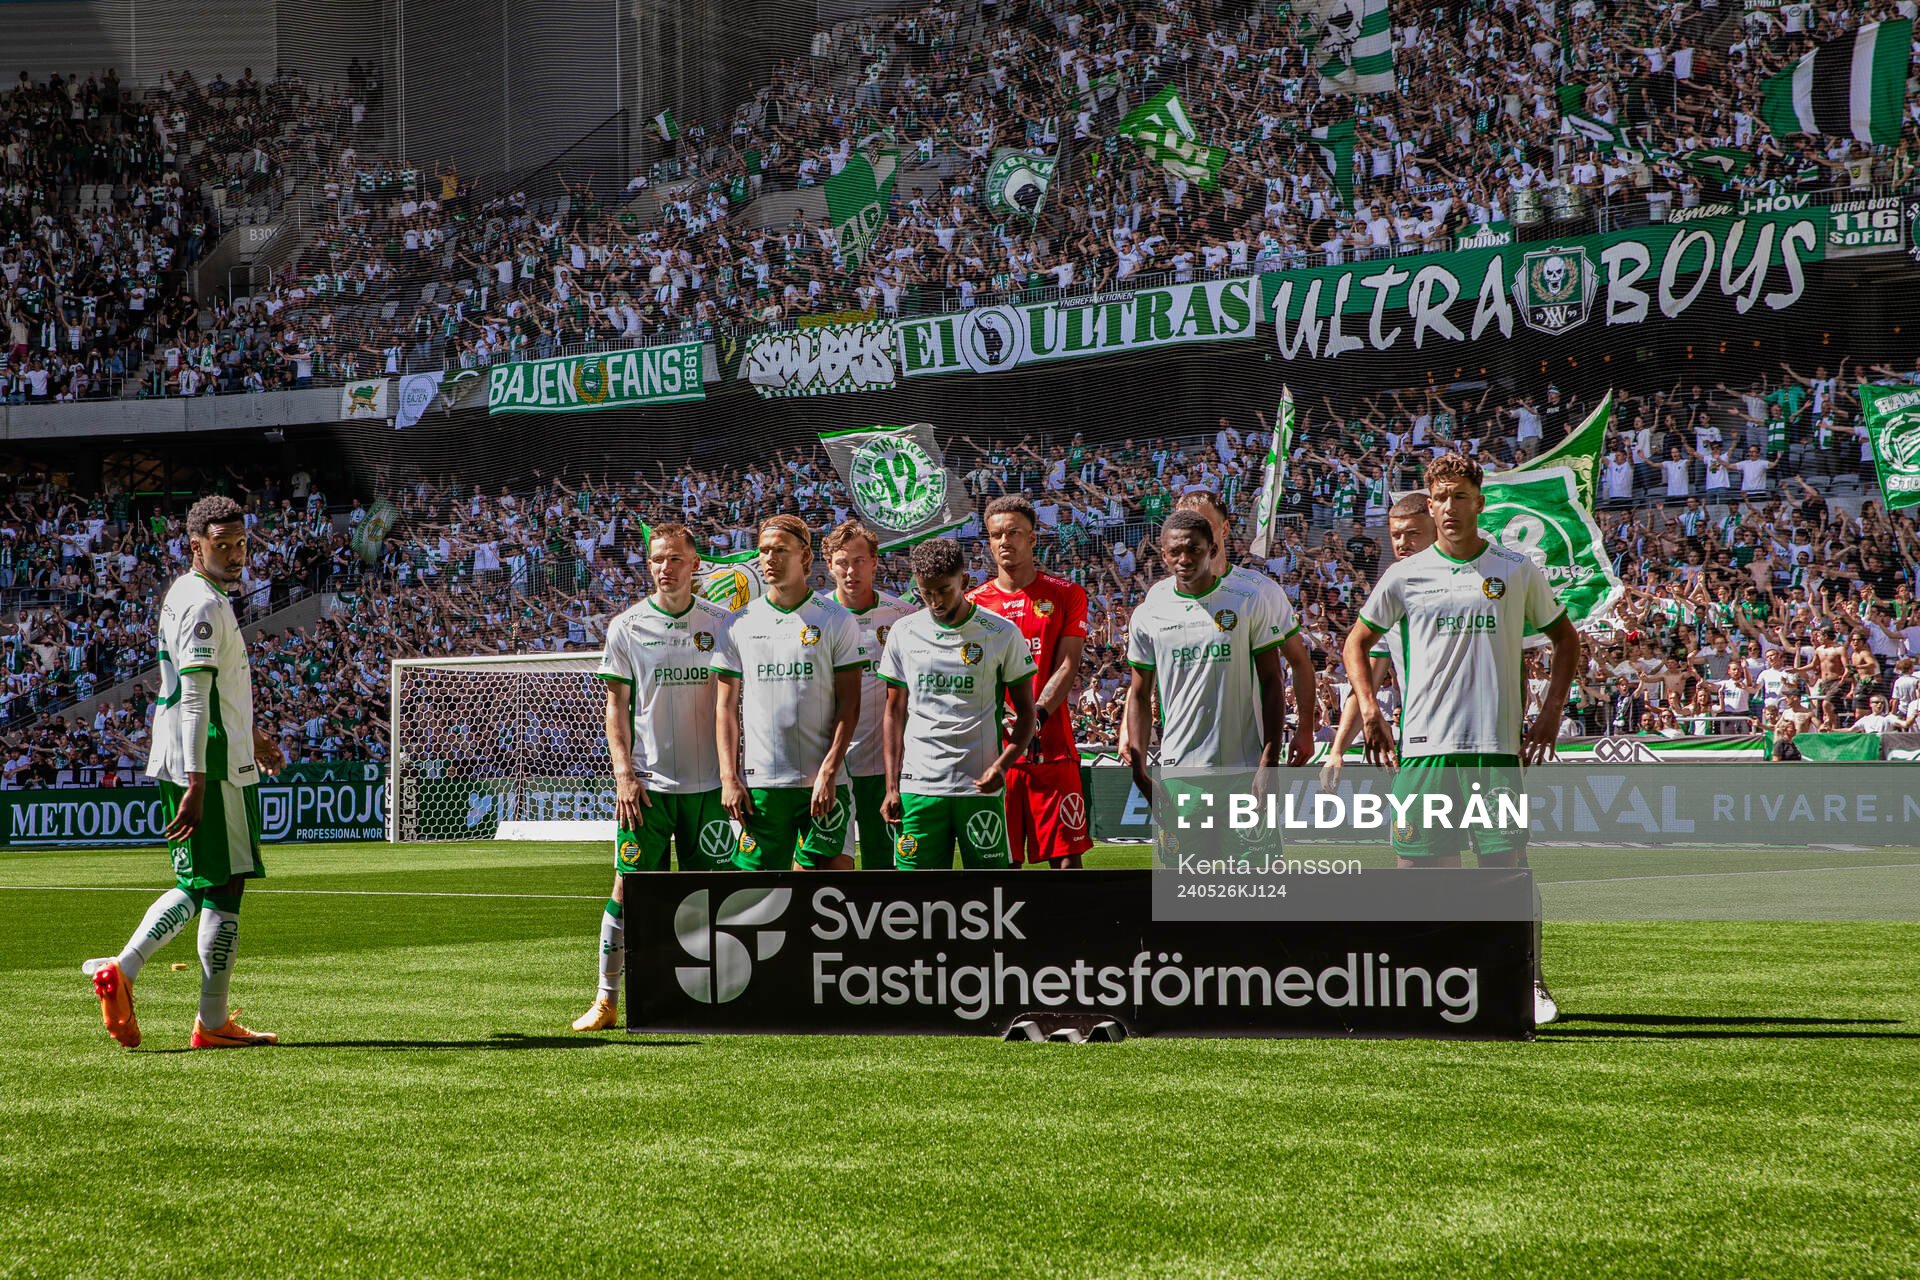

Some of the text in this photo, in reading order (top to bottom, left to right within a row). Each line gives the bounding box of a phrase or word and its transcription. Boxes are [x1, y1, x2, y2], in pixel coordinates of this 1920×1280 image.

[1738, 193, 1810, 216] J-HOV
[1830, 196, 1900, 213] ULTRA BOYS
[1830, 209, 1899, 231] 116
[1829, 229, 1898, 245] SOFIA
[1271, 219, 1817, 360] ULTRA BOYS
[1027, 279, 1252, 356] ULTRAS
[817, 324, 896, 388] BOYS
[489, 361, 578, 406] BAJEN
[607, 348, 681, 399] FANS
[684, 346, 699, 391] 1981
[1437, 615, 1497, 632] PROJOB
[189, 647, 215, 655] UNIBET
[1172, 643, 1232, 663] PROJOB
[654, 667, 709, 682] PROJOB
[757, 662, 814, 677] PROJOB
[918, 673, 974, 689] PROJOB
[297, 828, 361, 840] PROFESSIONAL
[147, 903, 191, 941] Clinton.
[812, 887, 1027, 941] Svensk
[212, 920, 238, 975] Clinton.
[812, 951, 1480, 1024] Fastighetsförmedling
